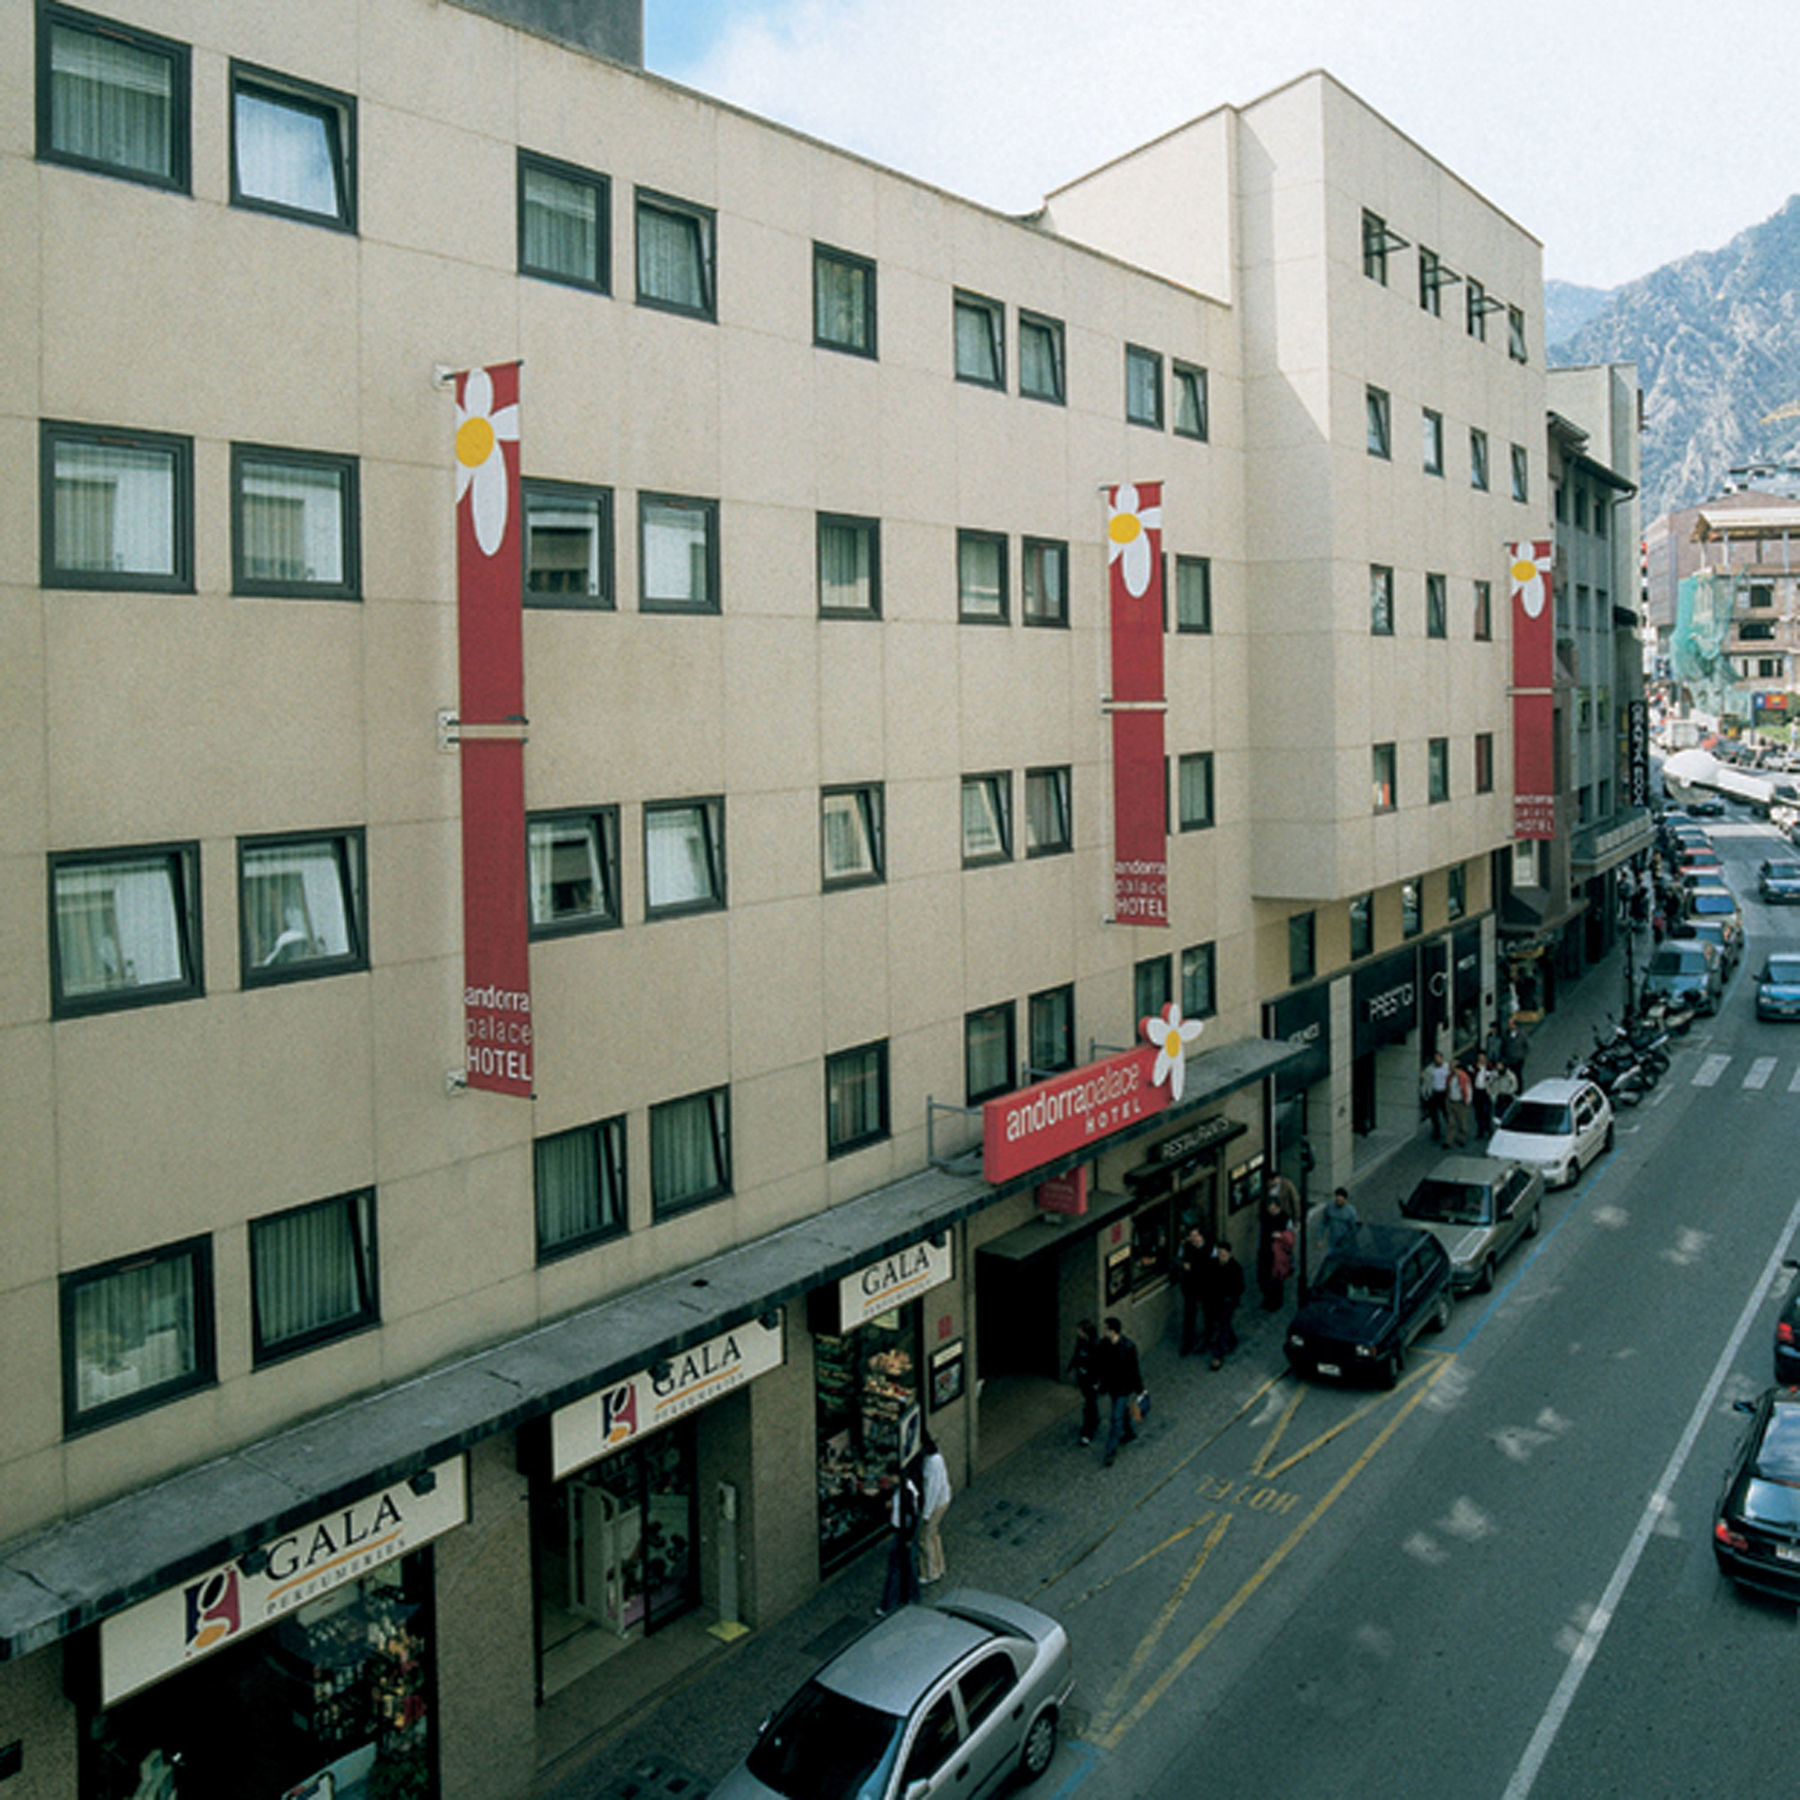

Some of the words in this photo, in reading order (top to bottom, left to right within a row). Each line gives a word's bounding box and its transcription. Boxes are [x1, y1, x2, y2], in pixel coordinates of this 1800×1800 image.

[1115, 897, 1166, 918] HOTEL
[464, 984, 530, 1012] andorra
[466, 1016, 532, 1045] palace
[466, 1046, 532, 1081] HOTEL
[1085, 1099, 1142, 1136] HOTEL
[862, 1246, 930, 1295] GALA
[265, 1493, 402, 1581] GALA
